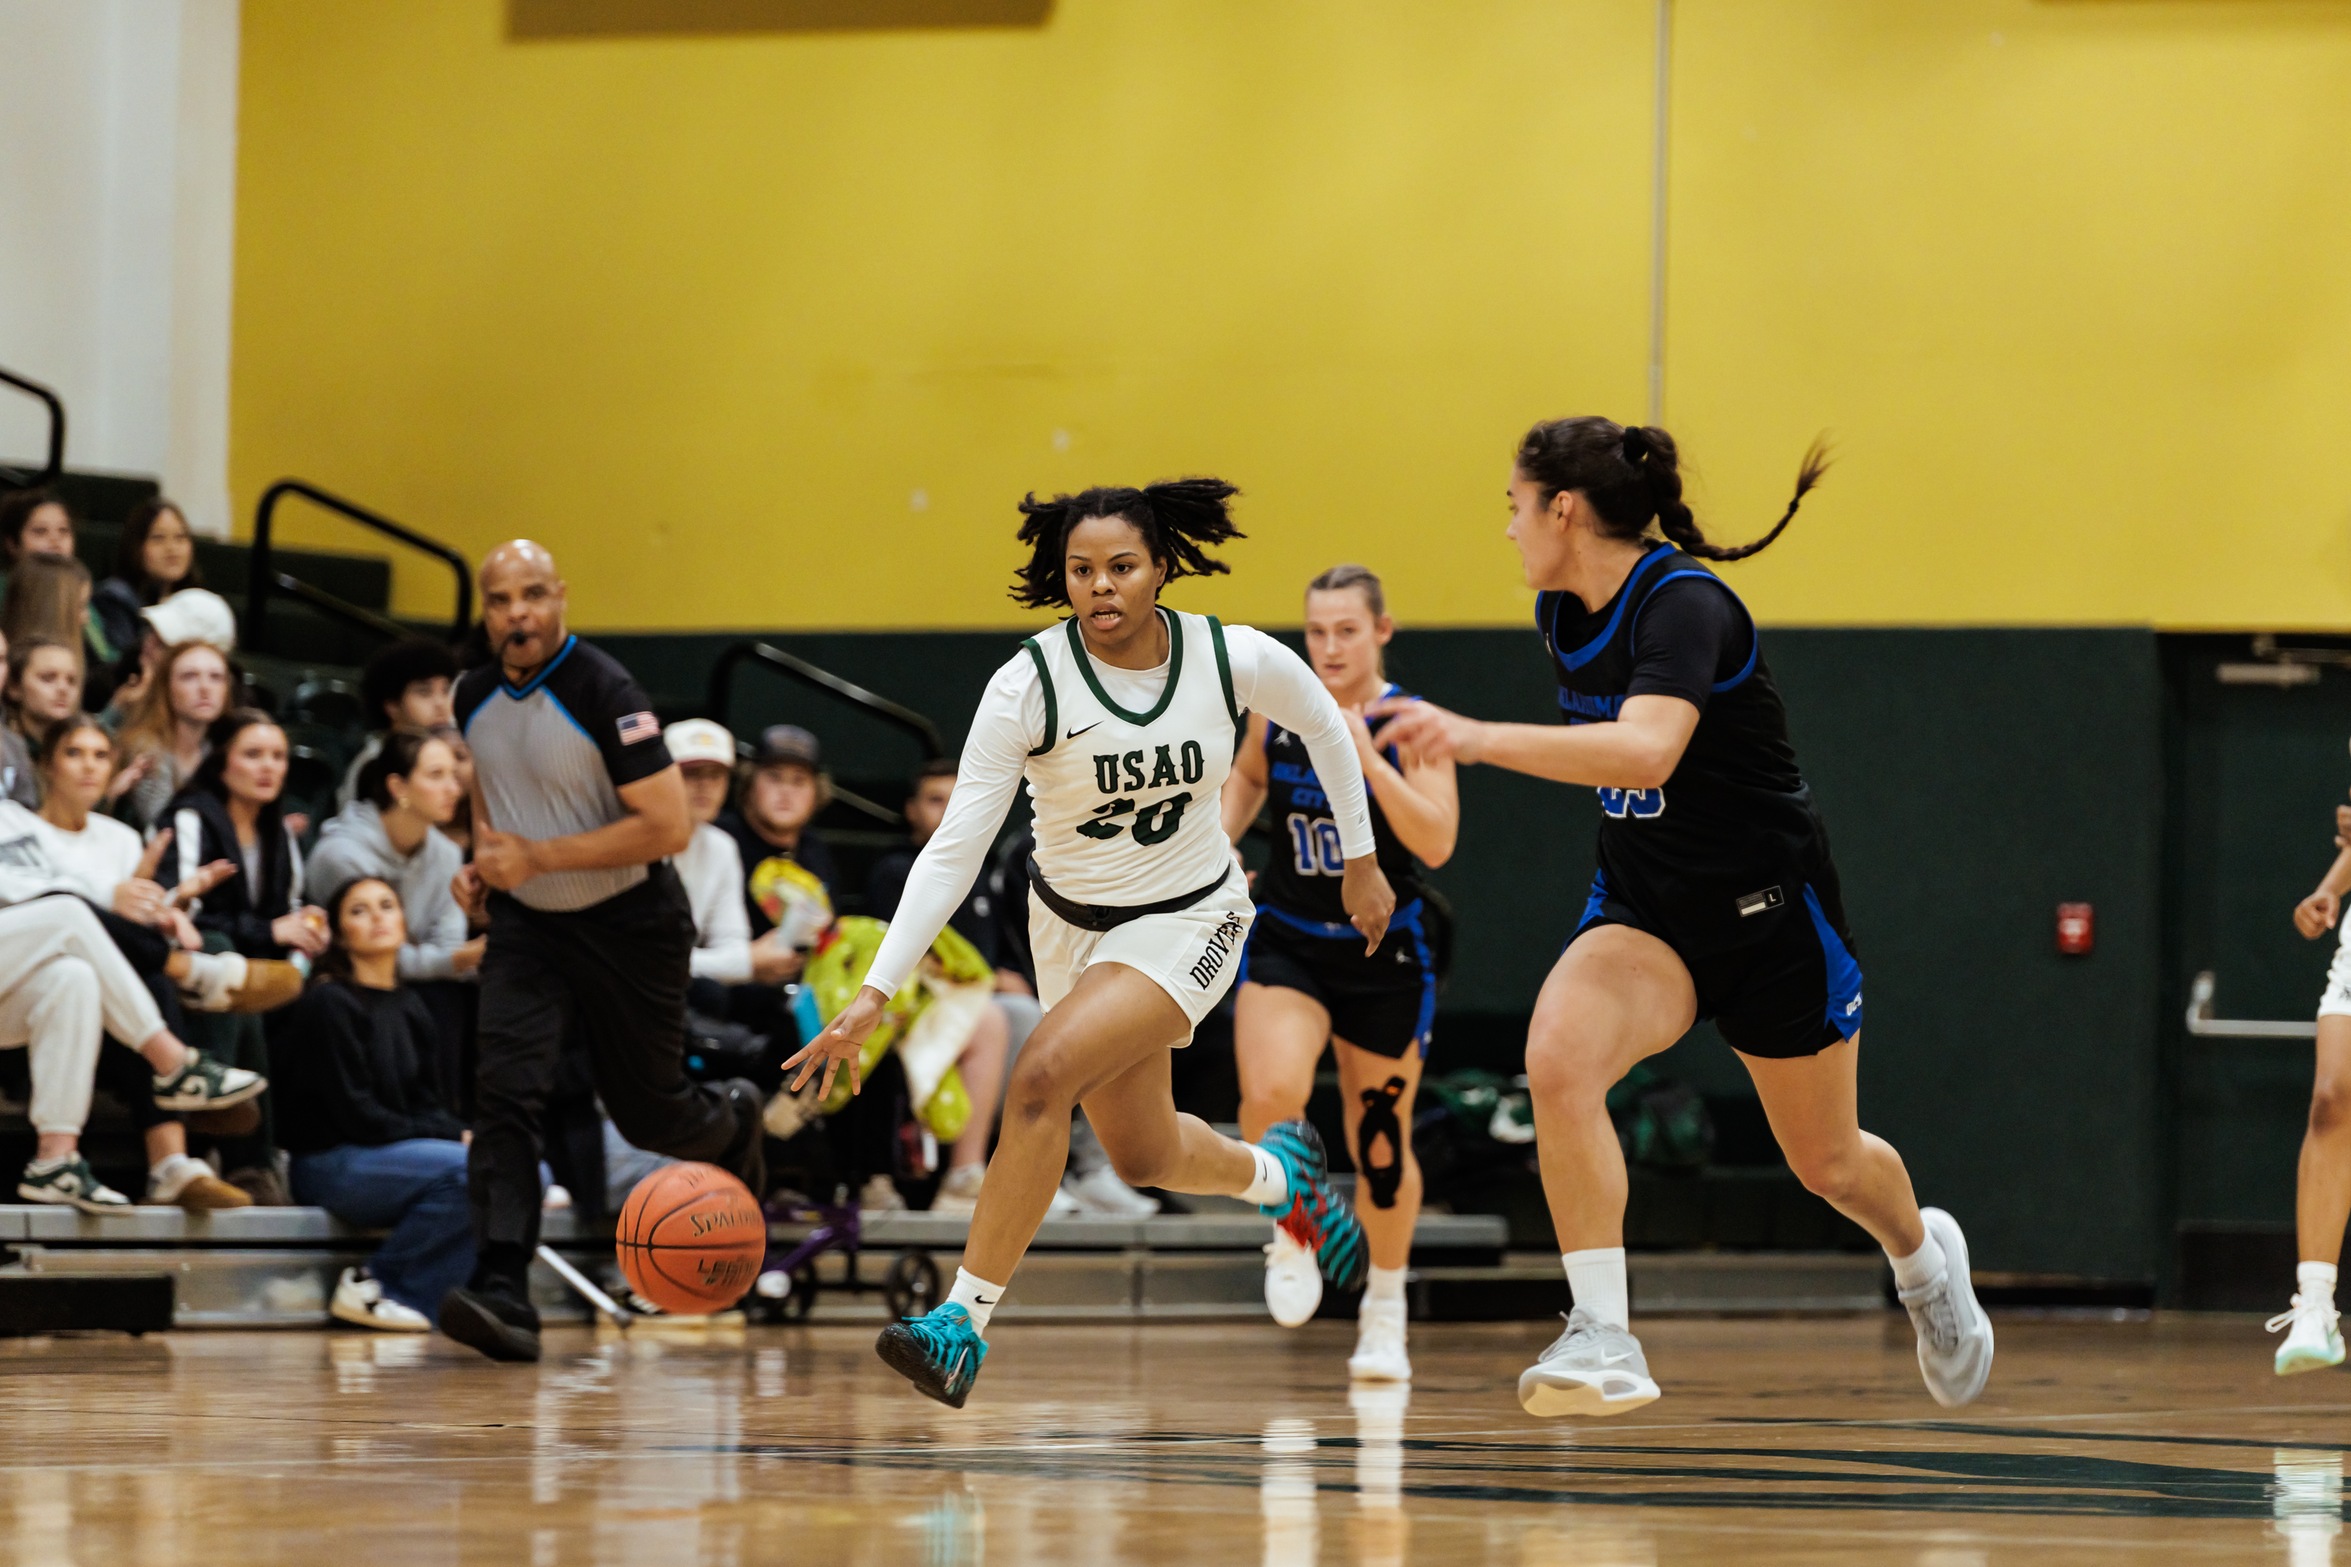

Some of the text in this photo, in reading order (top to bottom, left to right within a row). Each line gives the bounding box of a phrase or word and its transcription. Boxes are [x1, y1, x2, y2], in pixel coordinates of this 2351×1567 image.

[1093, 740, 1205, 794] USAO
[1076, 792, 1193, 846] 20
[1287, 812, 1344, 877] 10
